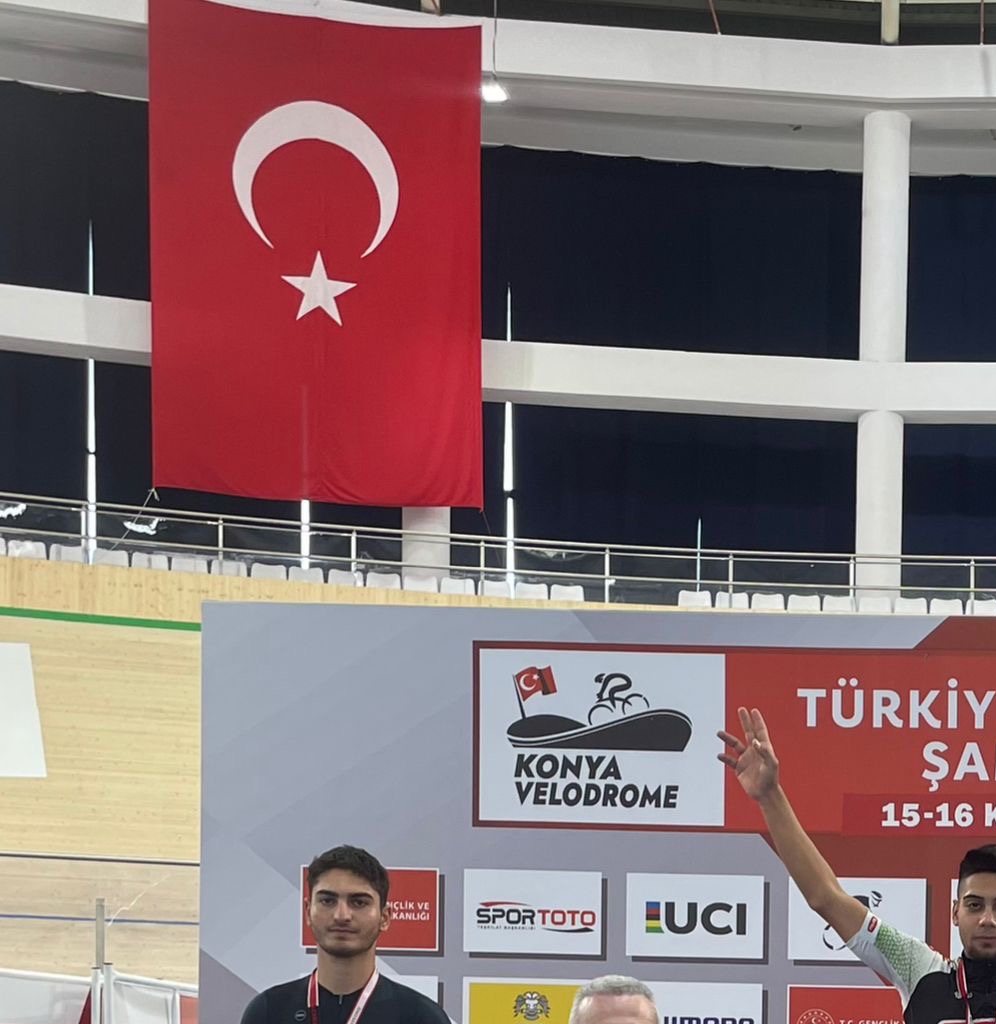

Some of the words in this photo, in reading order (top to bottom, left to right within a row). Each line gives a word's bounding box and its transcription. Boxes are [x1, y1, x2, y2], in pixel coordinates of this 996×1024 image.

[514, 754, 622, 780] KONYA
[515, 782, 679, 808] VELODROME
[881, 803, 974, 828] 15-16
[392, 911, 430, 921] KANLIĞI
[417, 902, 430, 910] VE
[665, 902, 747, 935] UCI
